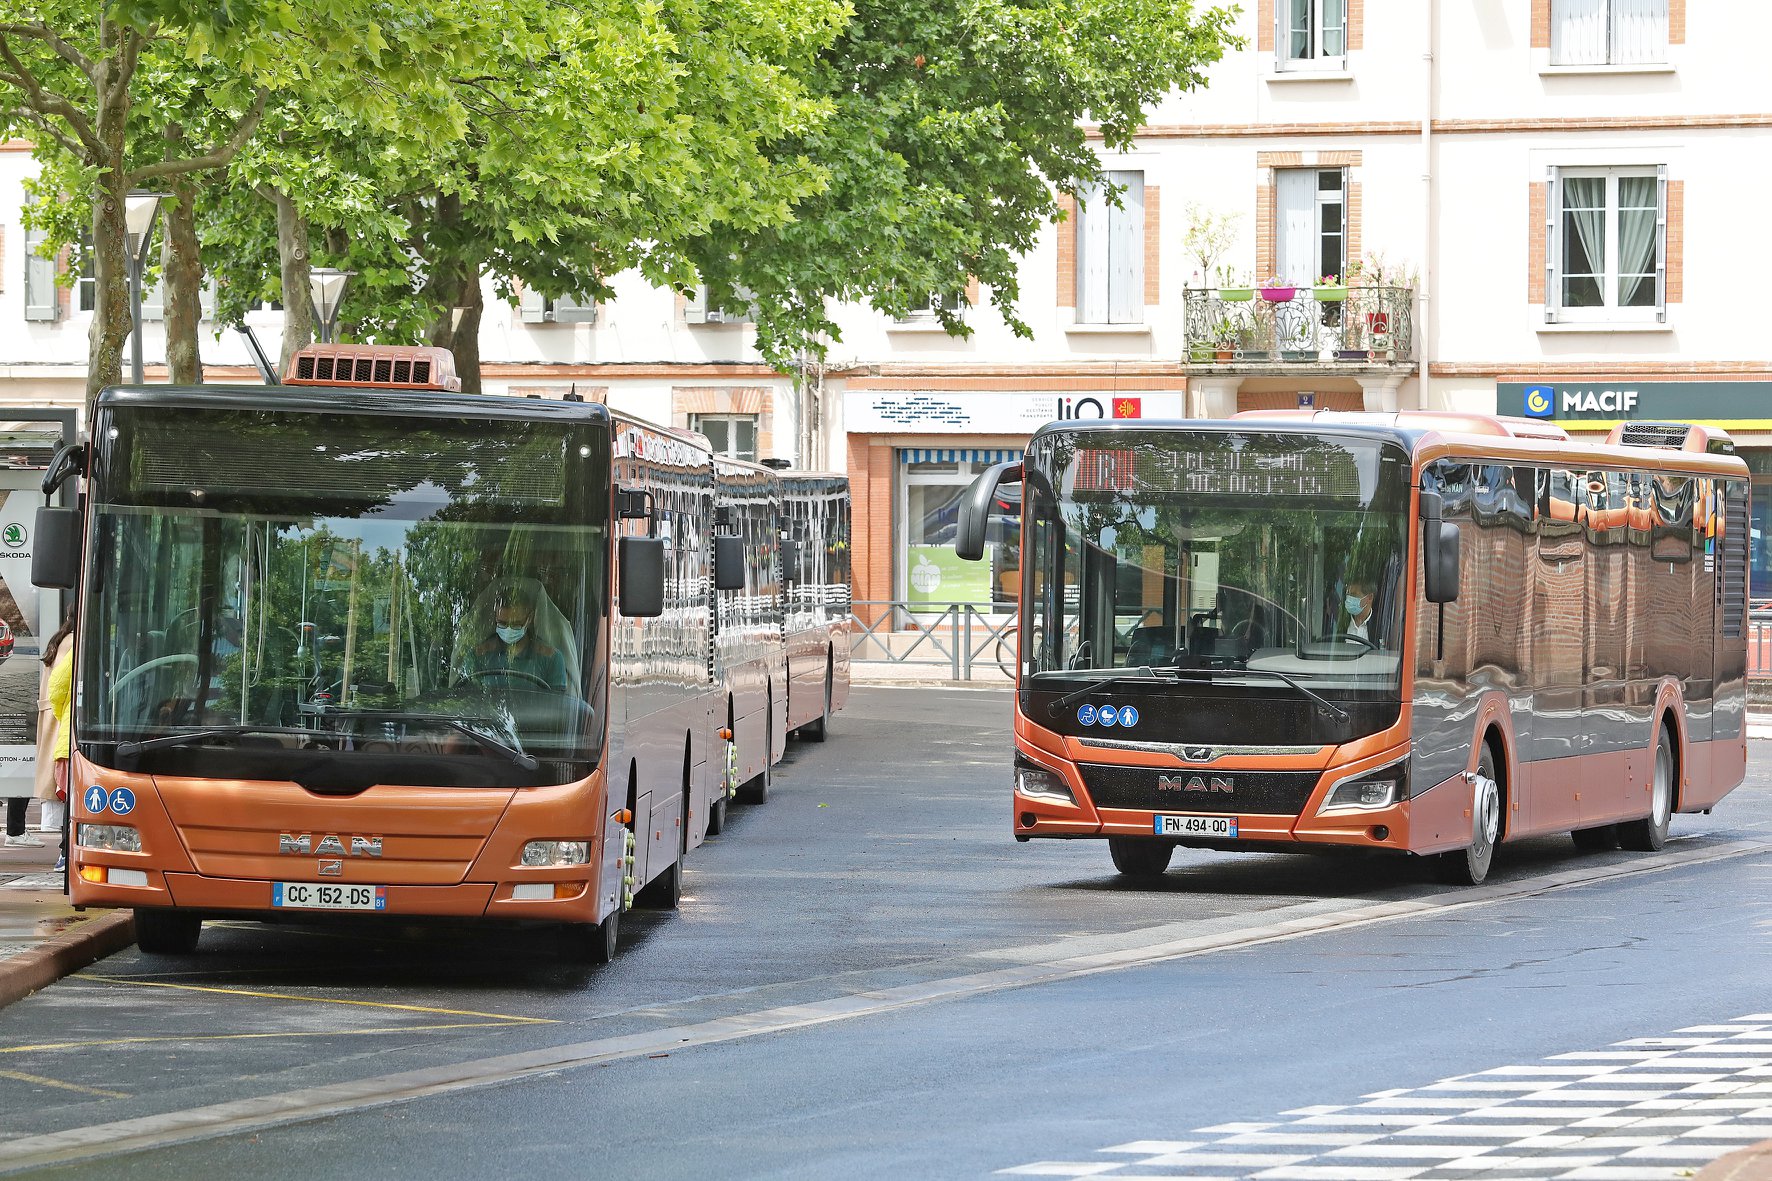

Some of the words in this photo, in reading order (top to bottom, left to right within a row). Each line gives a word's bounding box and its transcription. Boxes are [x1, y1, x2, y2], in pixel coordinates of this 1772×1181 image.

[1562, 390, 1638, 412] MACIF
[1158, 775, 1234, 794] MAN
[279, 833, 384, 858] MAN
[375, 898, 385, 907] 81
